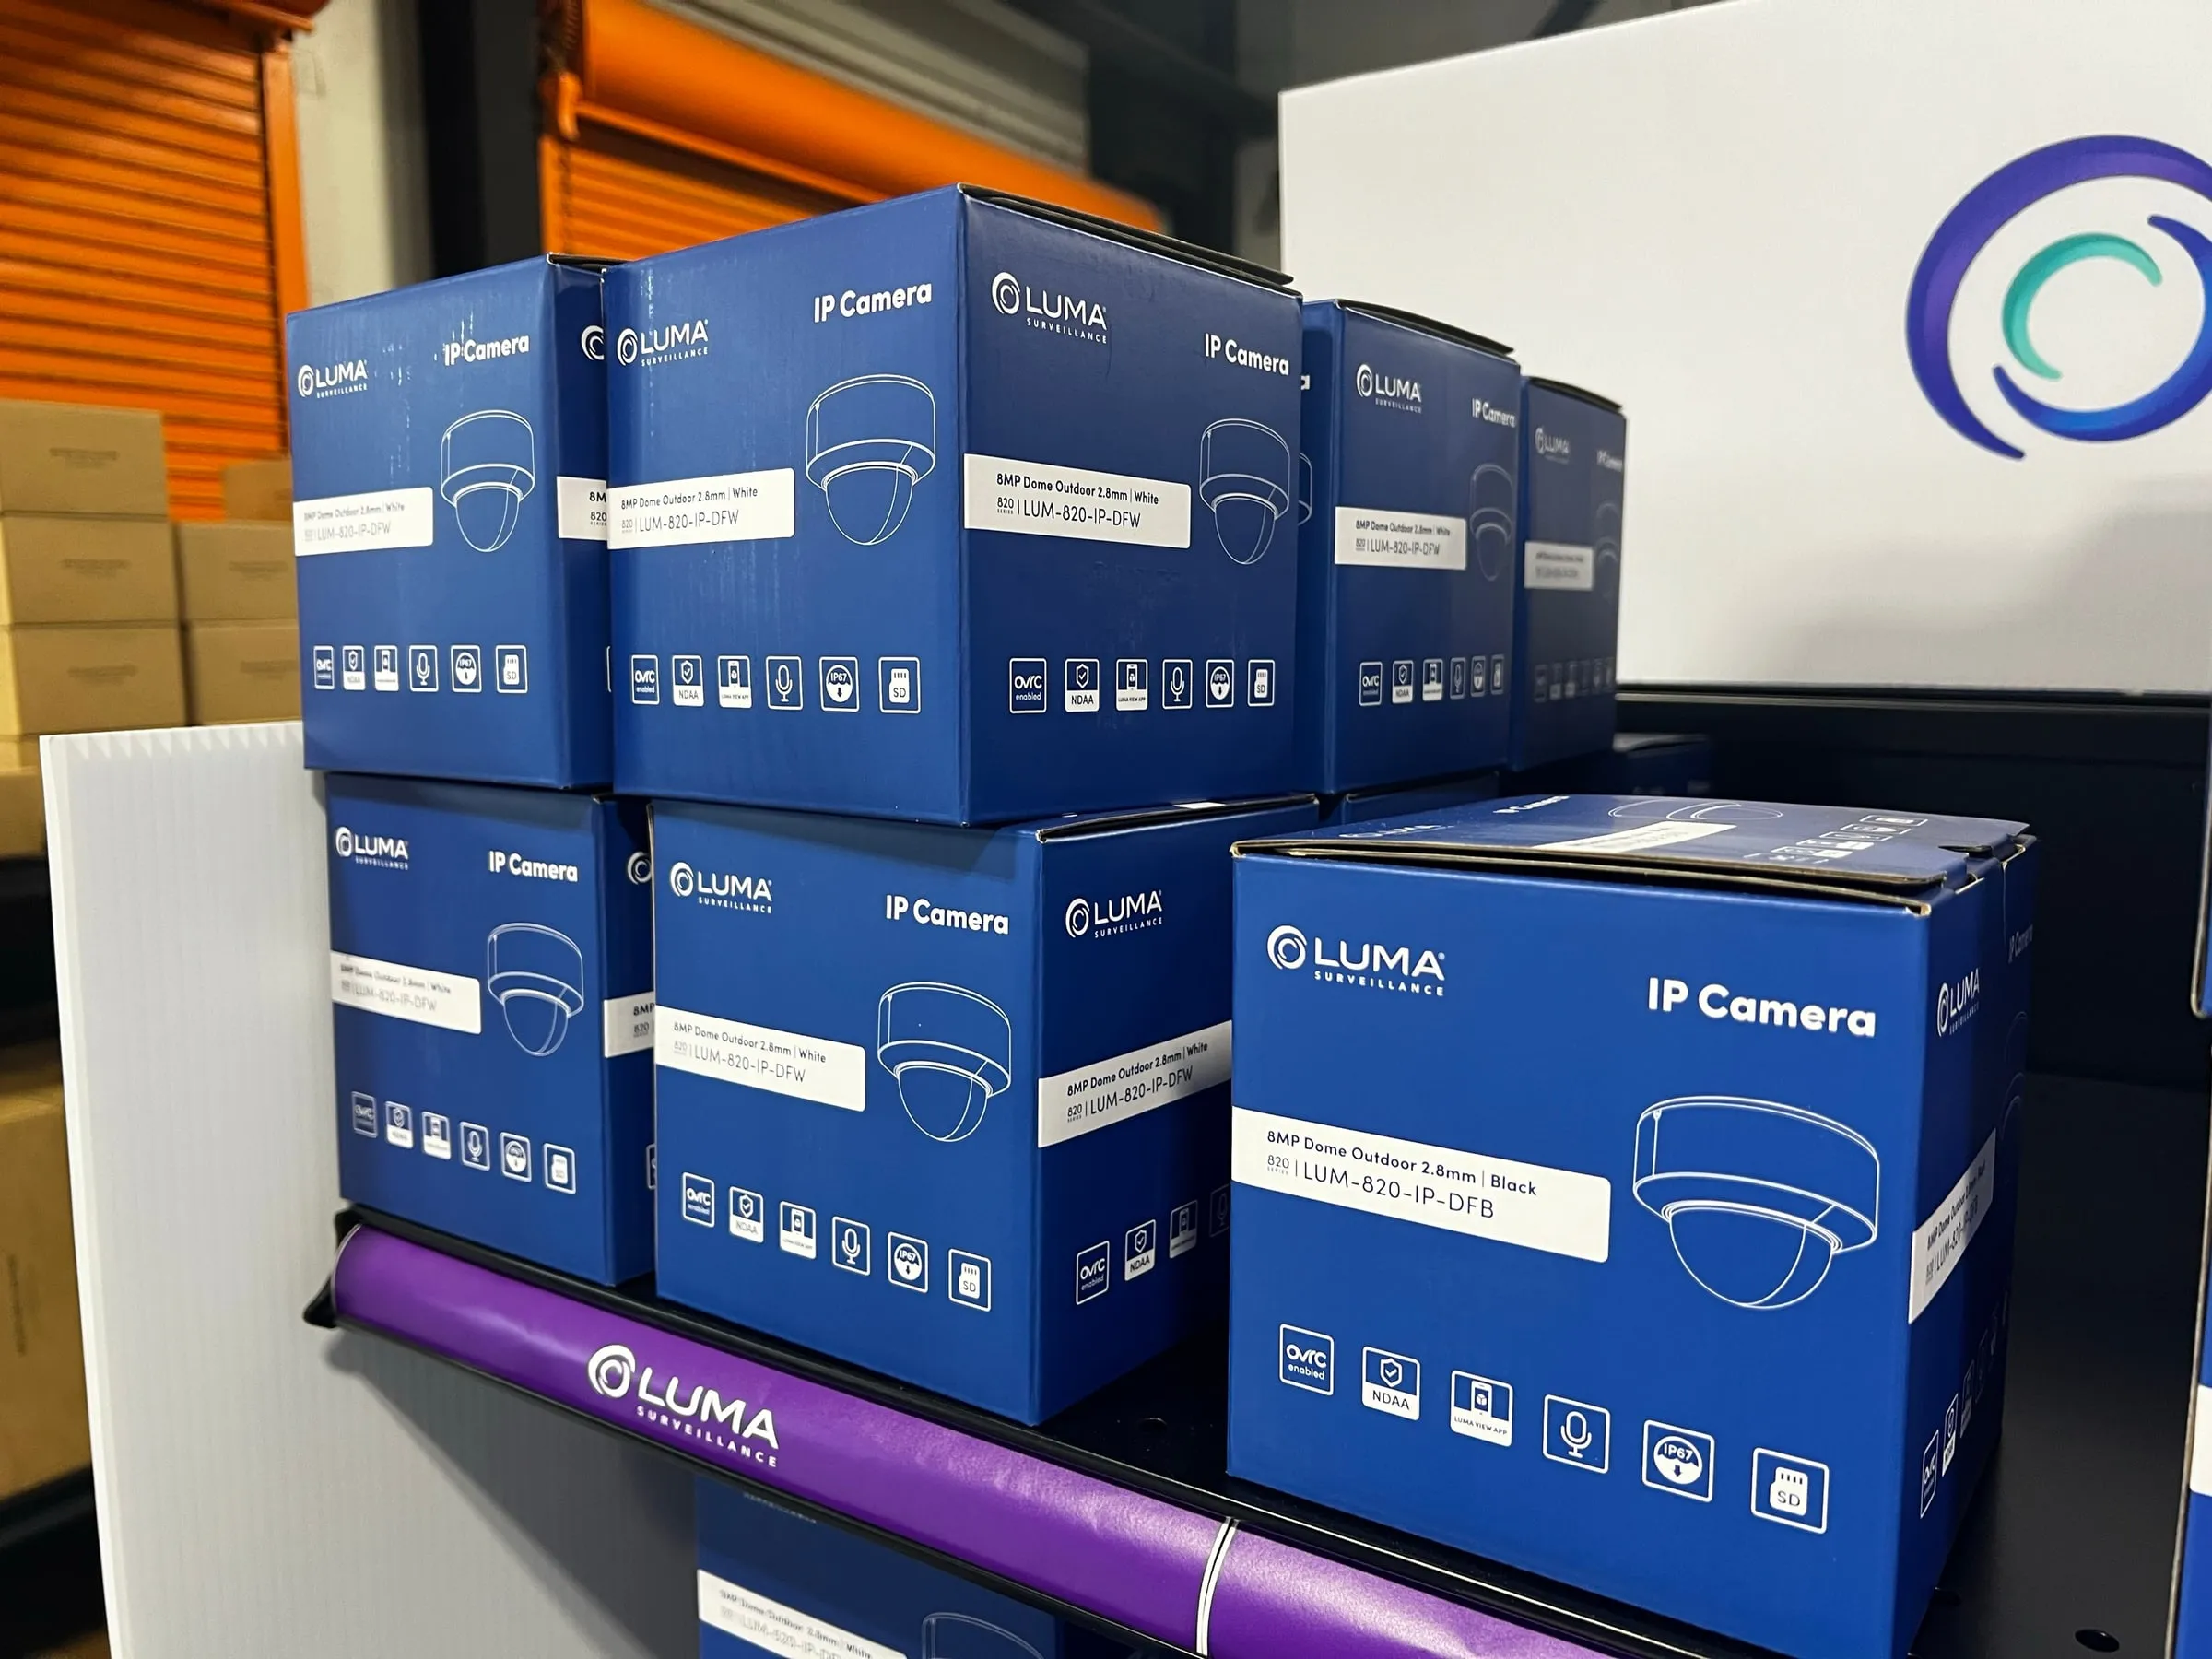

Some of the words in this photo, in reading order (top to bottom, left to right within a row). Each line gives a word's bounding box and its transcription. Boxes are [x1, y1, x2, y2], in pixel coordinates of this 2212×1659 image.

[814, 295, 835, 323] IP
[840, 282, 932, 317] Camera
[1026, 286, 1107, 330] LUMA
[641, 321, 708, 354] LUMA
[1027, 318, 1107, 344] SURVEILLANCE
[444, 342, 460, 365] IP
[464, 335, 529, 363] Camera
[641, 347, 708, 367] SURVEILLANCE
[1204, 333, 1221, 358] IP
[1225, 339, 1289, 376] Camera
[316, 360, 368, 388] LUMA
[1375, 373, 1421, 403] LUMA
[1472, 398, 1481, 418] IP
[1482, 403, 1516, 428] Camera
[589, 491, 606, 503] 8M
[621, 499, 637, 510] 8MP
[640, 498, 660, 508] Dome
[664, 493, 695, 505] Outdoor
[698, 490, 725, 502] 2.8mm
[733, 487, 758, 499] White
[996, 474, 1020, 488] 8MP
[1024, 477, 1053, 491] Dome
[1055, 480, 1096, 497] Outdoor
[1098, 487, 1128, 501] 2.8mm
[1134, 490, 1159, 505] White
[591, 512, 607, 522] 820
[640, 509, 739, 532] LUM-820-IP-DFW
[997, 497, 1014, 509] 820
[1024, 500, 1141, 528] LUM-820-IP-DFW
[830, 673, 847, 683] IP67
[1256, 684, 1265, 694] SD
[678, 689, 699, 700] NDAA
[893, 688, 906, 698] SD
[1015, 692, 1041, 701] enabled
[1071, 695, 1094, 706] NDAA
[355, 833, 408, 859] LUMA
[488, 851, 505, 873] IP
[509, 853, 579, 882] Camera
[698, 870, 772, 901] LUMA
[699, 896, 772, 914] SURVEILLANCE
[886, 894, 909, 920] IP
[913, 899, 1009, 935] Camera
[1094, 891, 1162, 924] LUMA
[1095, 917, 1162, 938] SURVEILLANCE
[1314, 937, 1445, 981] LUMA
[1314, 971, 1443, 996] SURVEILLANCE
[1949, 968, 1980, 1018] LUMA
[1649, 977, 1688, 1012] IP
[1698, 983, 1876, 1038] Camera
[674, 1021, 692, 1033] 8MP
[695, 1026, 719, 1041] Dome
[722, 1031, 758, 1049] Outdoor
[760, 1041, 792, 1055] 2.8mm
[799, 1047, 826, 1063] White
[695, 1044, 806, 1083] LUM-820-IP-DFW
[1067, 1080, 1088, 1096] 8MP
[1091, 1073, 1115, 1089] Dome
[1118, 1061, 1153, 1079] Outdoor
[1155, 1051, 1181, 1067] 2.8mm
[1186, 1041, 1207, 1056] White
[1068, 1103, 1082, 1117] 820
[1091, 1065, 1193, 1114] LUM-820-IP-DFW
[1267, 1130, 1300, 1147] 8MP
[1304, 1136, 1347, 1158] Dome
[1351, 1147, 1417, 1171] Outdoor
[1421, 1161, 1476, 1184] 2.8mm
[1490, 1174, 1536, 1196] Black
[1267, 1154, 1289, 1169] 820
[1303, 1161, 1494, 1218] LUM-820-IP-DFB
[1130, 1255, 1150, 1272] NDAA
[963, 1280, 976, 1292] SD
[1288, 1363, 1324, 1381] enabled
[638, 1367, 779, 1450] LUMA
[1372, 1390, 1410, 1410] NDAA
[637, 1406, 776, 1467] SURVEILLANCE
[1476, 1422, 1492, 1431] VIEW
[1664, 1442, 1693, 1462] IP67
[1777, 1490, 1801, 1507] SD
